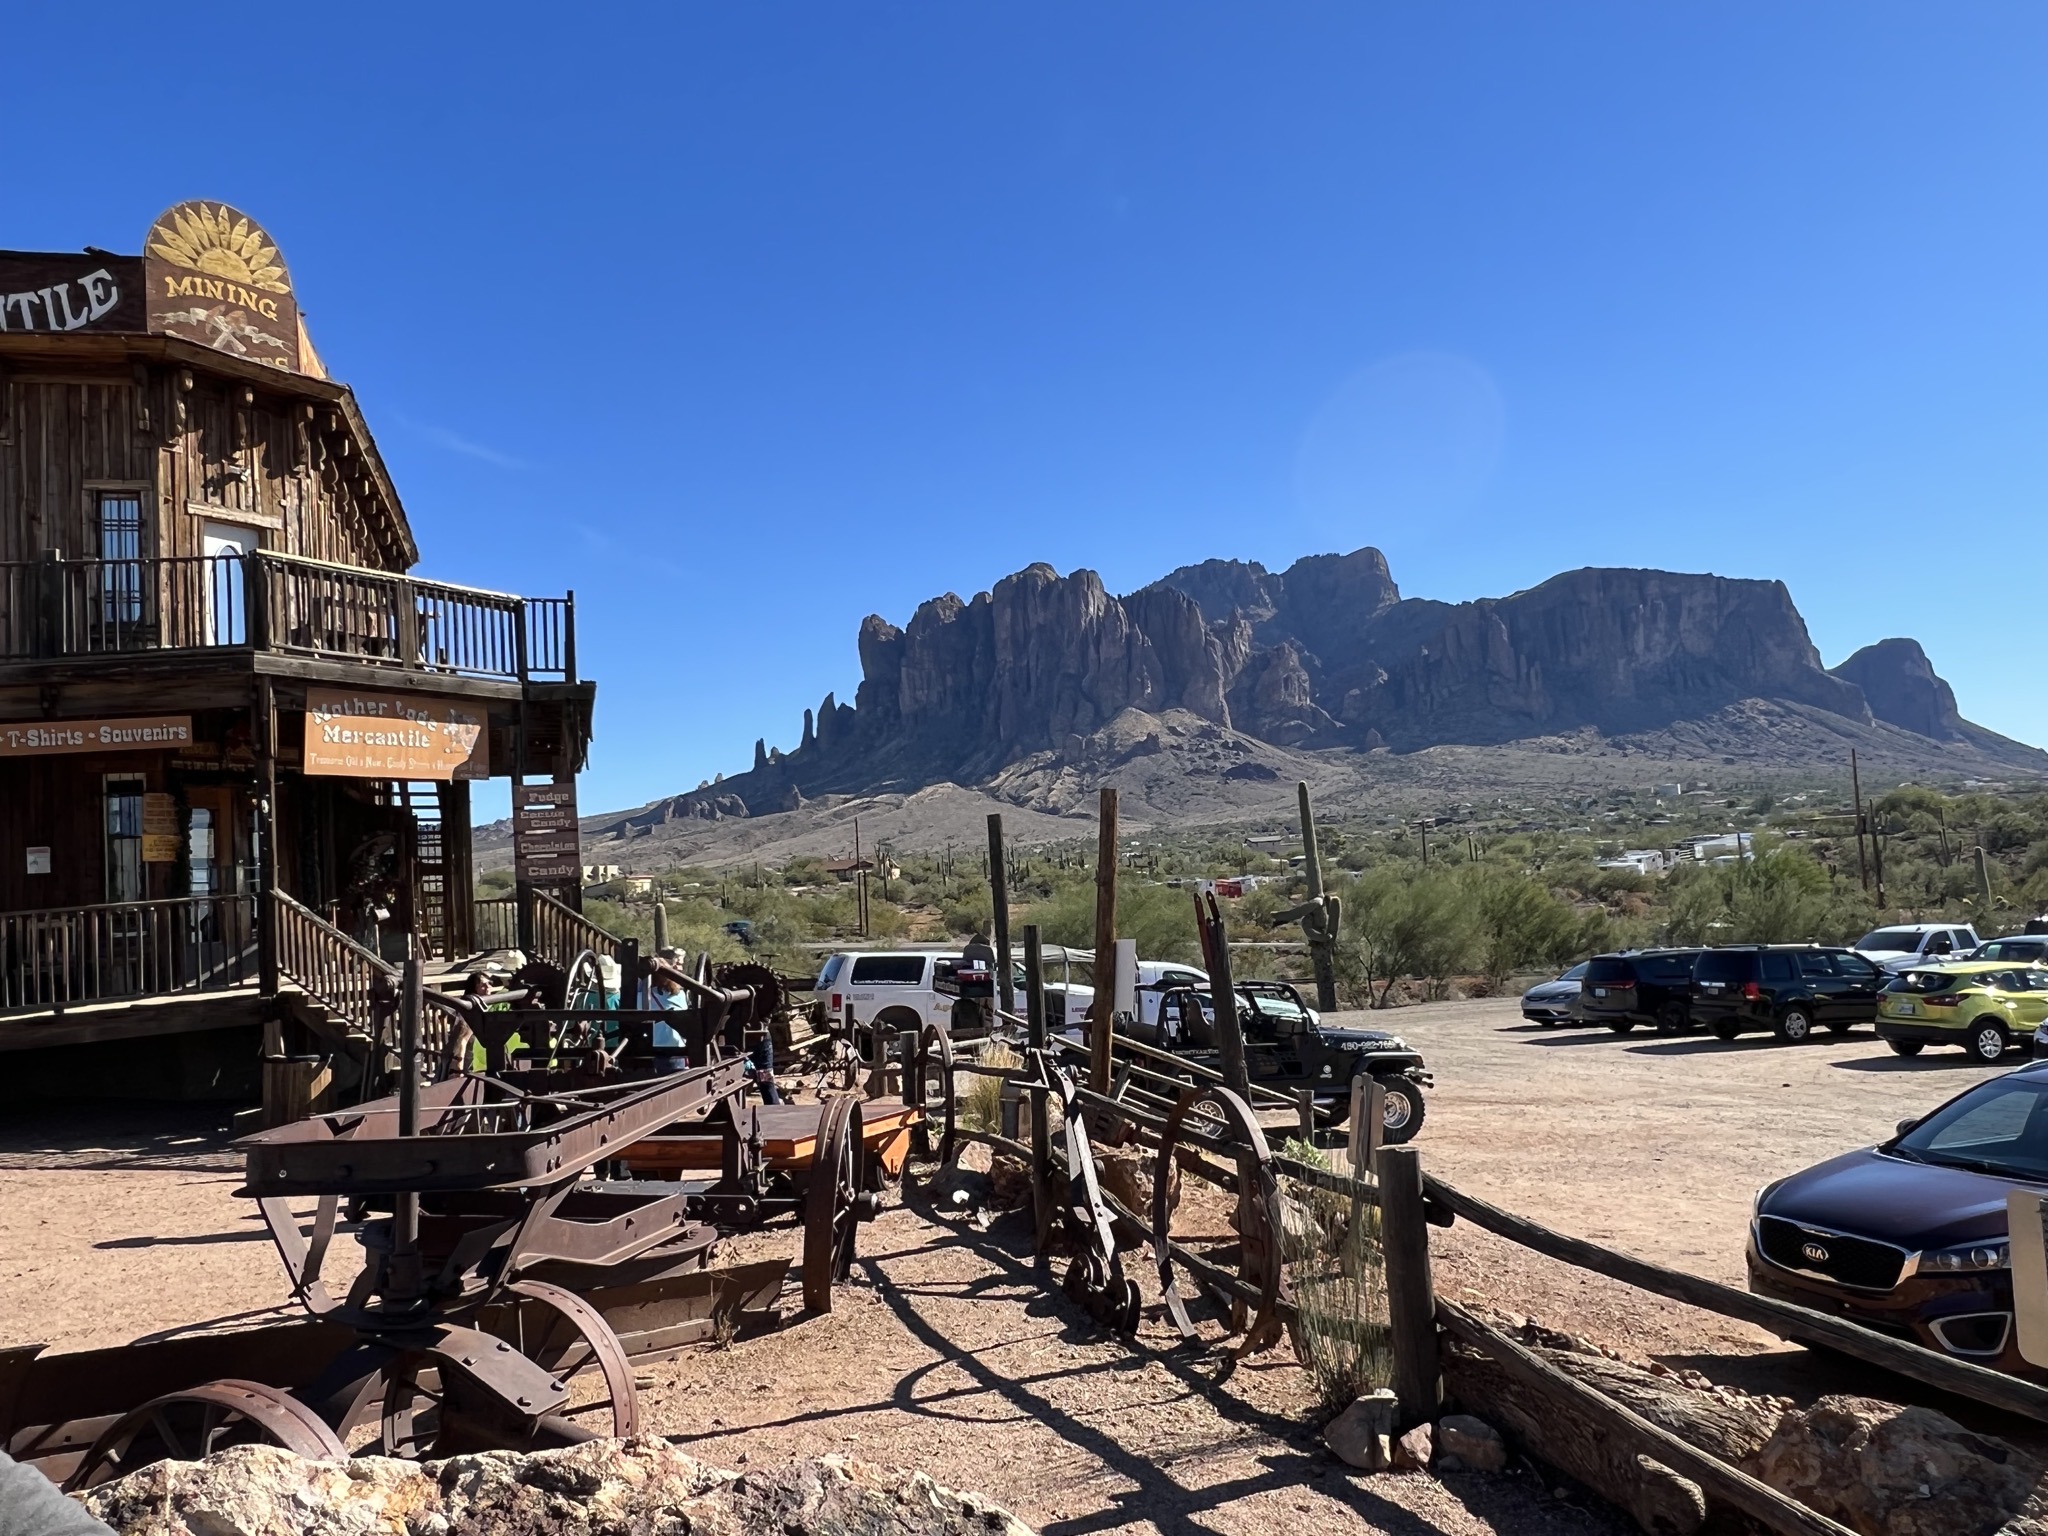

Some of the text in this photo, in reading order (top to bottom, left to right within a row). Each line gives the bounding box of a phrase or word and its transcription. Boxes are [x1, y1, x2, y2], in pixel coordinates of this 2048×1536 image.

[165, 275, 278, 322] MINING
[312, 698, 387, 725] Mother
[7, 724, 187, 748] T-Shirts Souvenirs
[323, 725, 430, 747] Mercantile
[529, 793, 569, 804] Fudge
[531, 818, 571, 828] Candy
[528, 865, 574, 876] Candy
[1805, 1245, 1825, 1260] KIA
